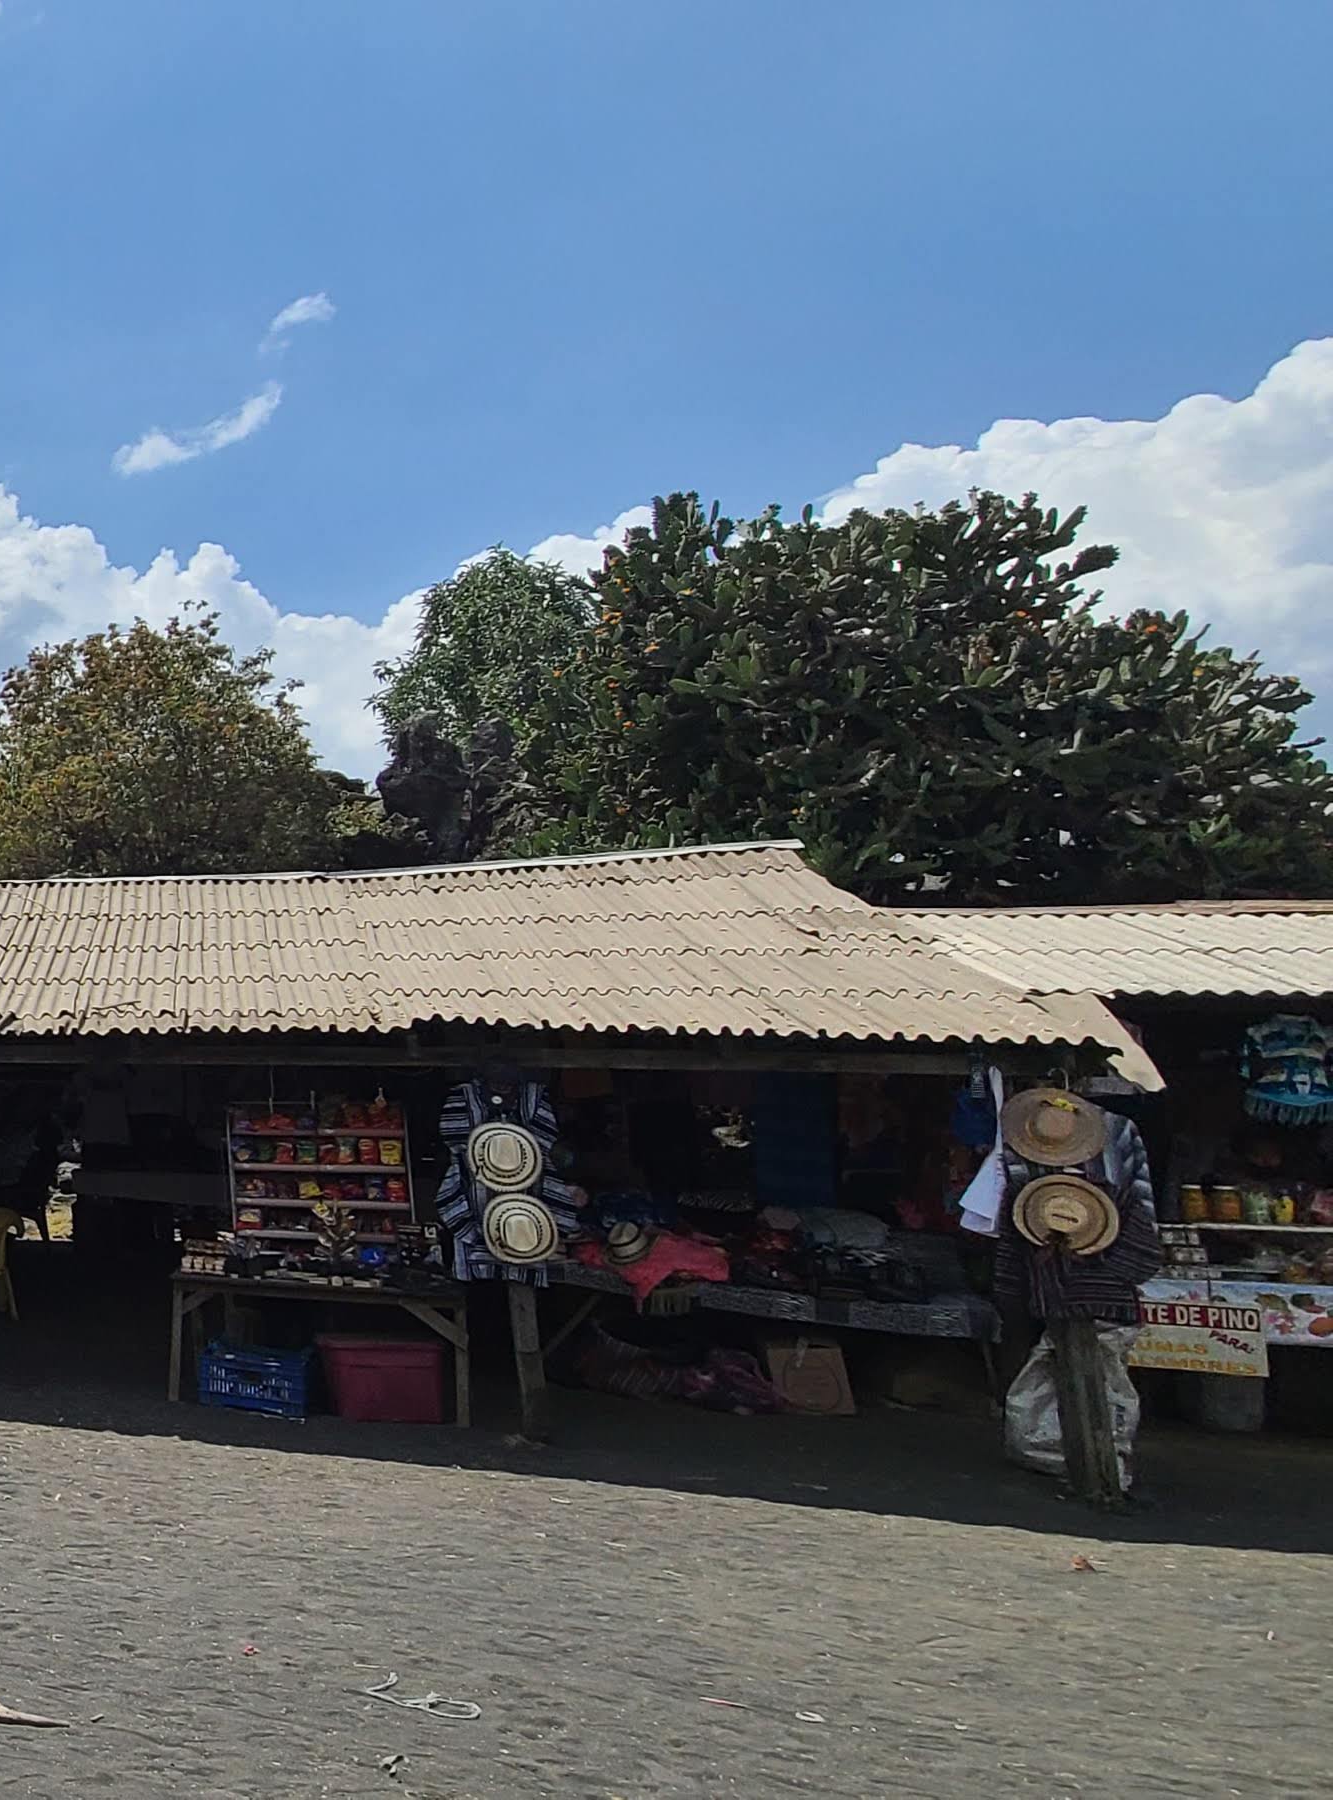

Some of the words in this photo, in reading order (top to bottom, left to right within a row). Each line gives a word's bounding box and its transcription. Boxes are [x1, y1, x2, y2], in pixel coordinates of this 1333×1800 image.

[1143, 1303, 1170, 1323] TE
[1175, 1306, 1202, 1326] DE
[1208, 1307, 1259, 1330] PINO
